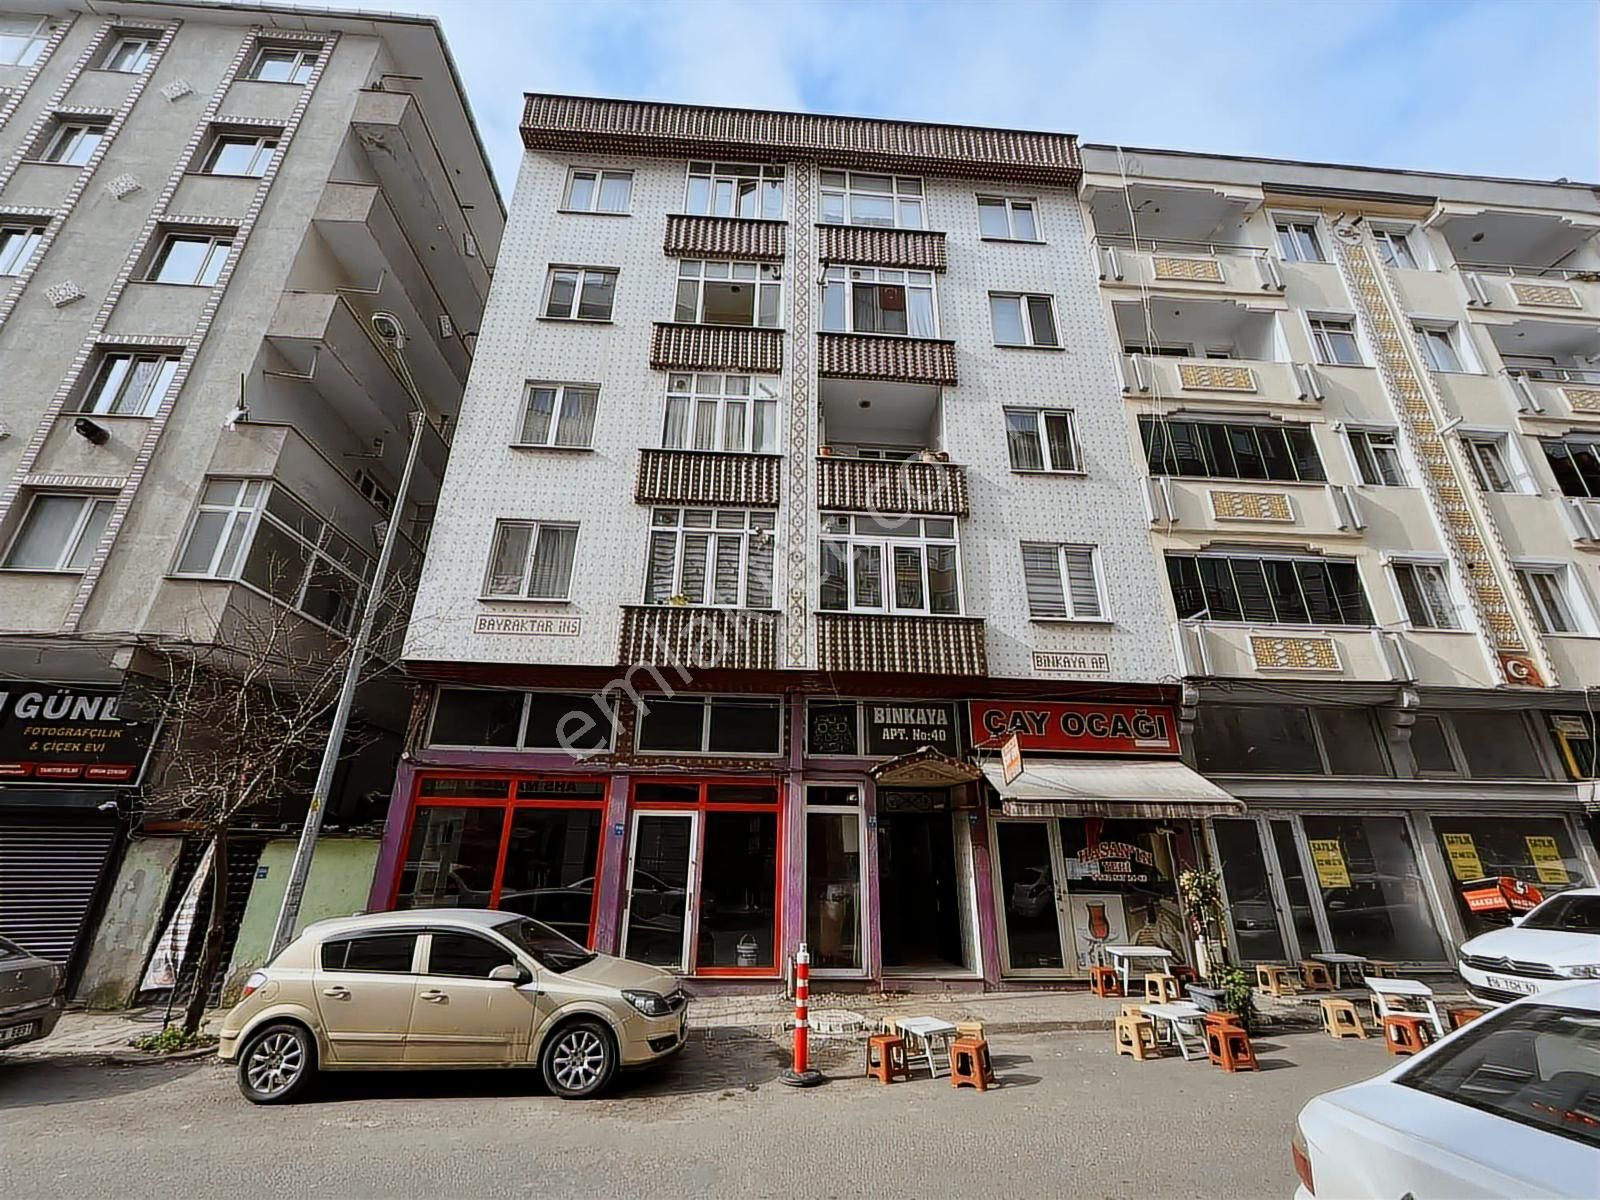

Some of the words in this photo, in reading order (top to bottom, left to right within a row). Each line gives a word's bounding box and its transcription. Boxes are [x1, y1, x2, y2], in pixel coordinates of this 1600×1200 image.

[479, 619, 553, 632] BAYRAKTAR
[1035, 655, 1087, 668] BİNKAYA
[873, 703, 948, 725] BİNKAYA
[983, 709, 1051, 739] ÇAY
[1060, 709, 1169, 739] OCAĞI
[23, 726, 123, 739] FOTOGRAFÇILIK
[882, 727, 909, 740] APT.
[912, 728, 946, 741] No:40
[43, 741, 80, 753] ÇİÇEK
